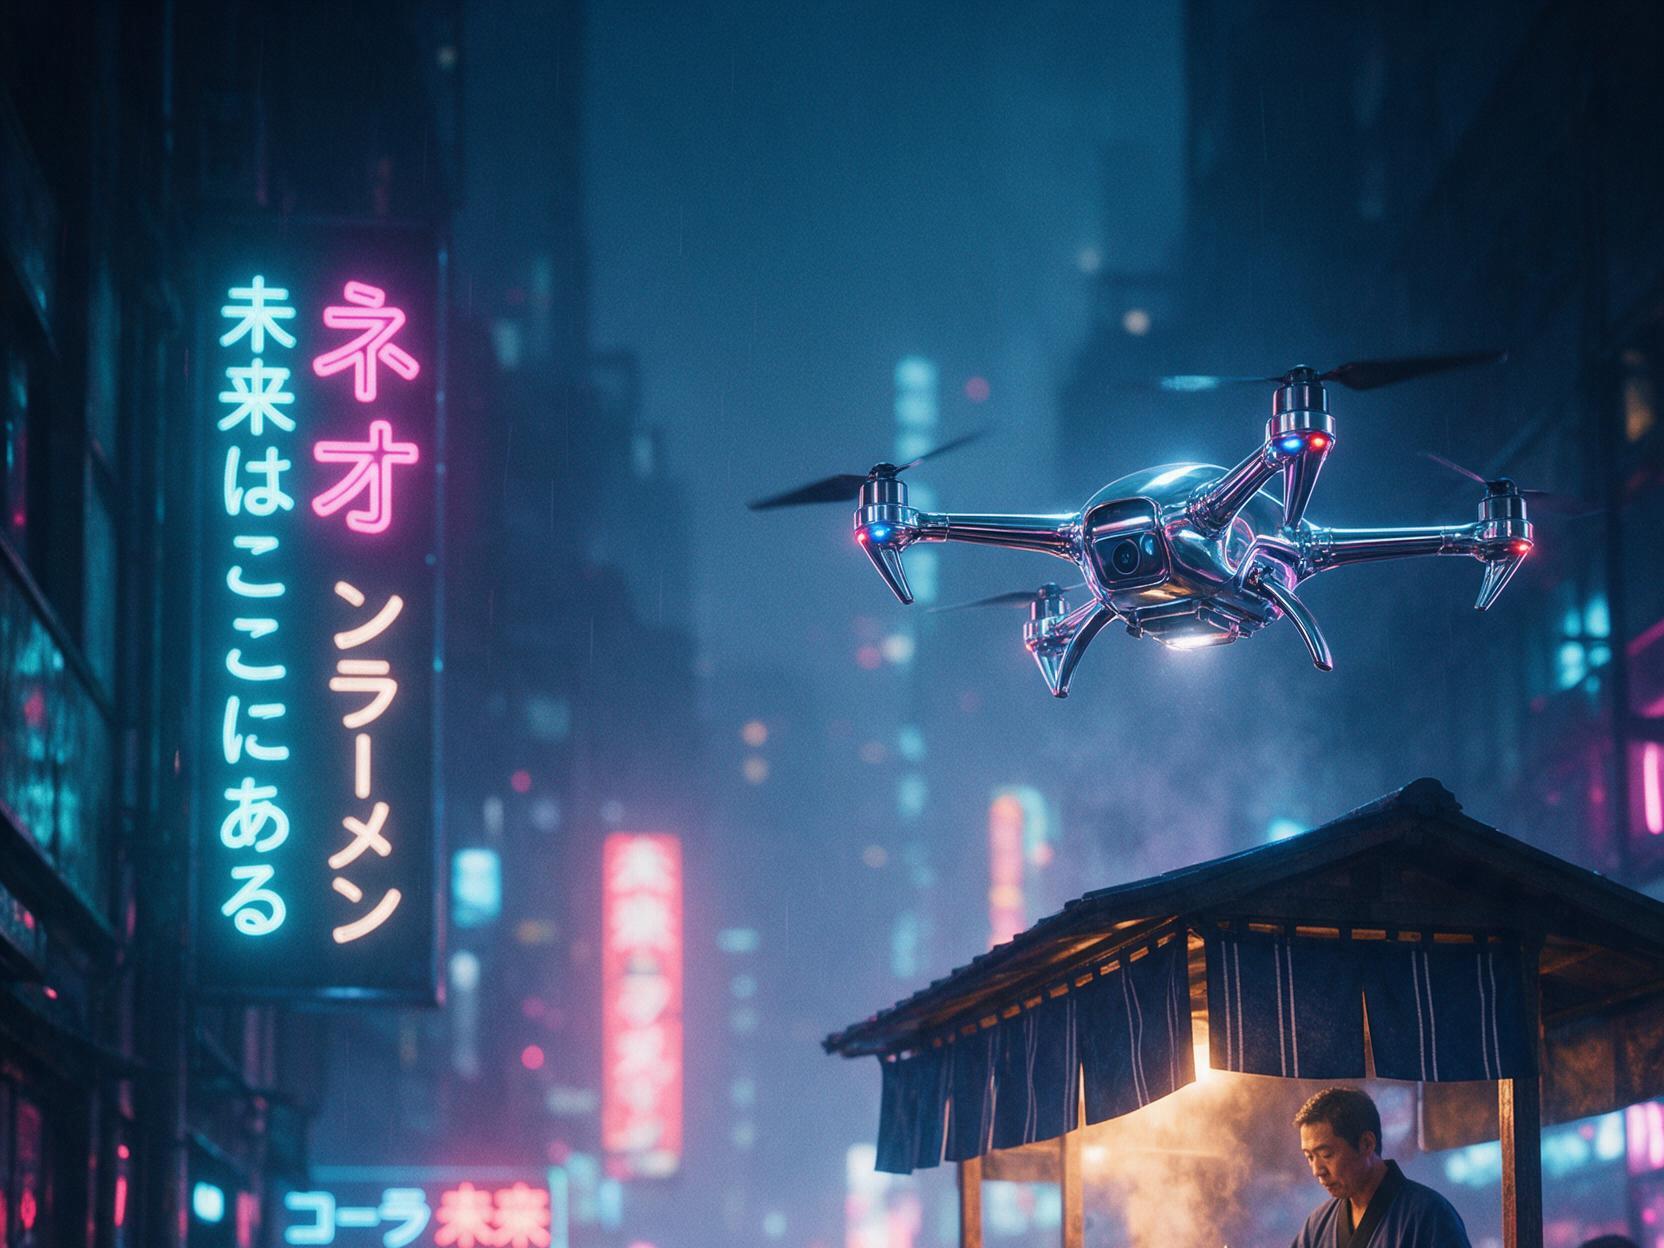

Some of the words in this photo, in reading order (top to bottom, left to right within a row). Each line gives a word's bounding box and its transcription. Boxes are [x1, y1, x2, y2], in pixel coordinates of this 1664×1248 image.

[217, 274, 297, 937] 未来はここにある
